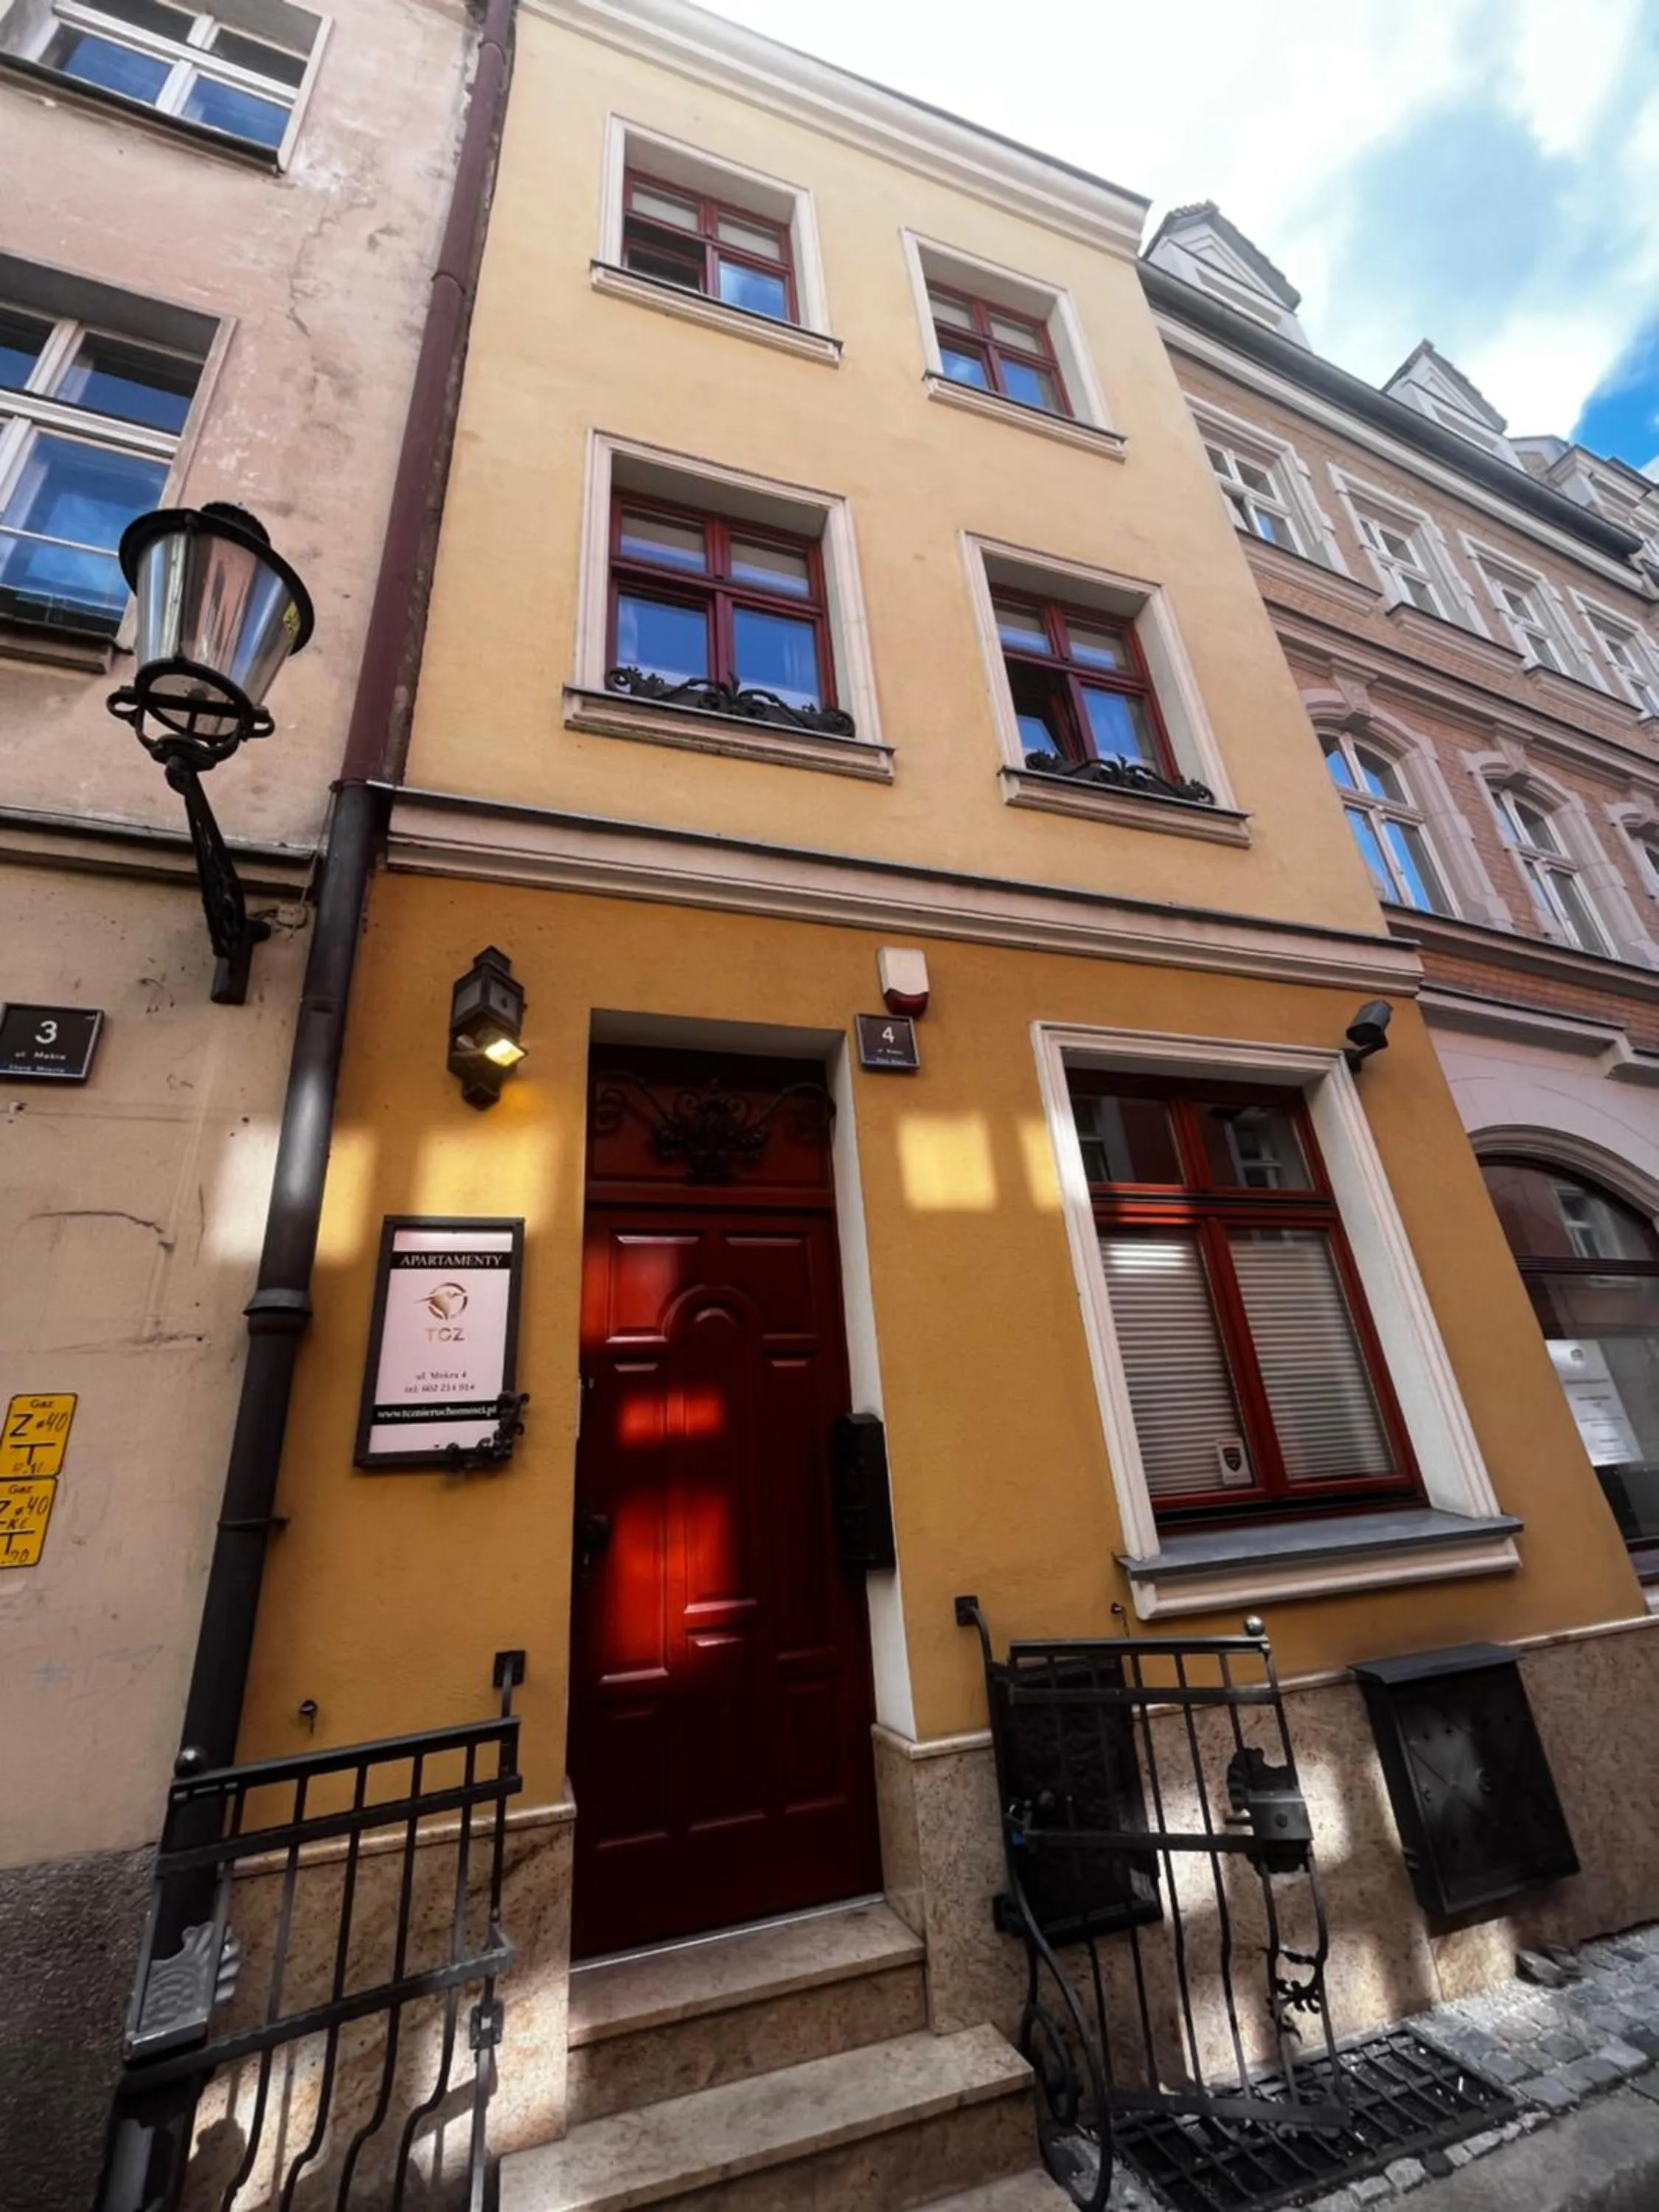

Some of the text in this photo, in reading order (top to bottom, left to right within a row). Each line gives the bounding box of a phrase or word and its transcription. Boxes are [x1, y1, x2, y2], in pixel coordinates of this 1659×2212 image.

[35, 1020, 58, 1044] 3
[881, 1026, 895, 1043] 4
[400, 1255, 502, 1266] APARTAMENTY
[10, 1413, 34, 1437] Z
